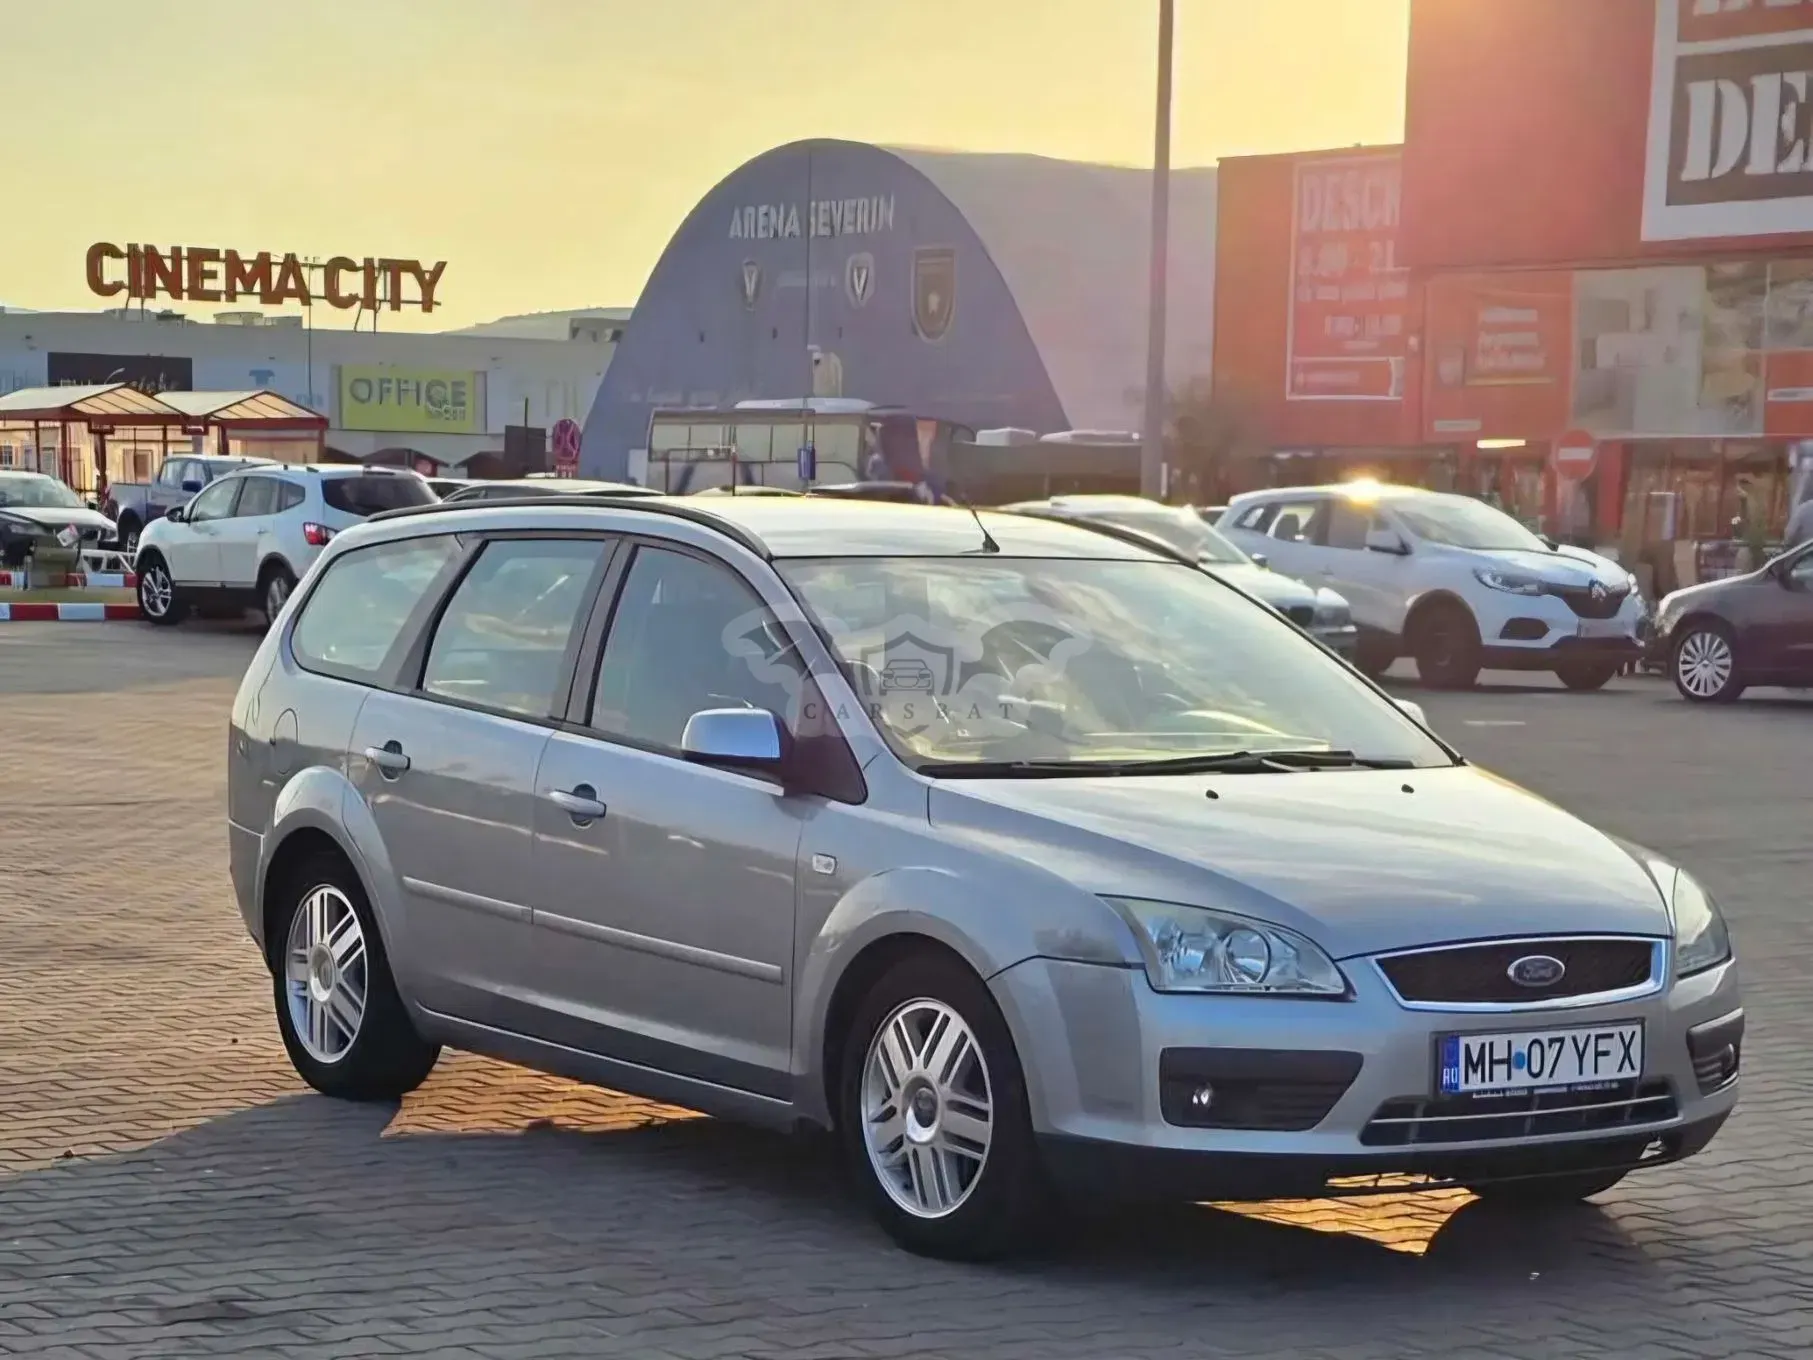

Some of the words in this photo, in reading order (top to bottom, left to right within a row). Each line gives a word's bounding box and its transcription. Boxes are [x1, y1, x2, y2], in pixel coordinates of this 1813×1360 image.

[729, 201, 801, 240] ARENA
[86, 242, 313, 306] CINEMA
[323, 256, 448, 313] CITY
[349, 377, 467, 409] OFFICE
